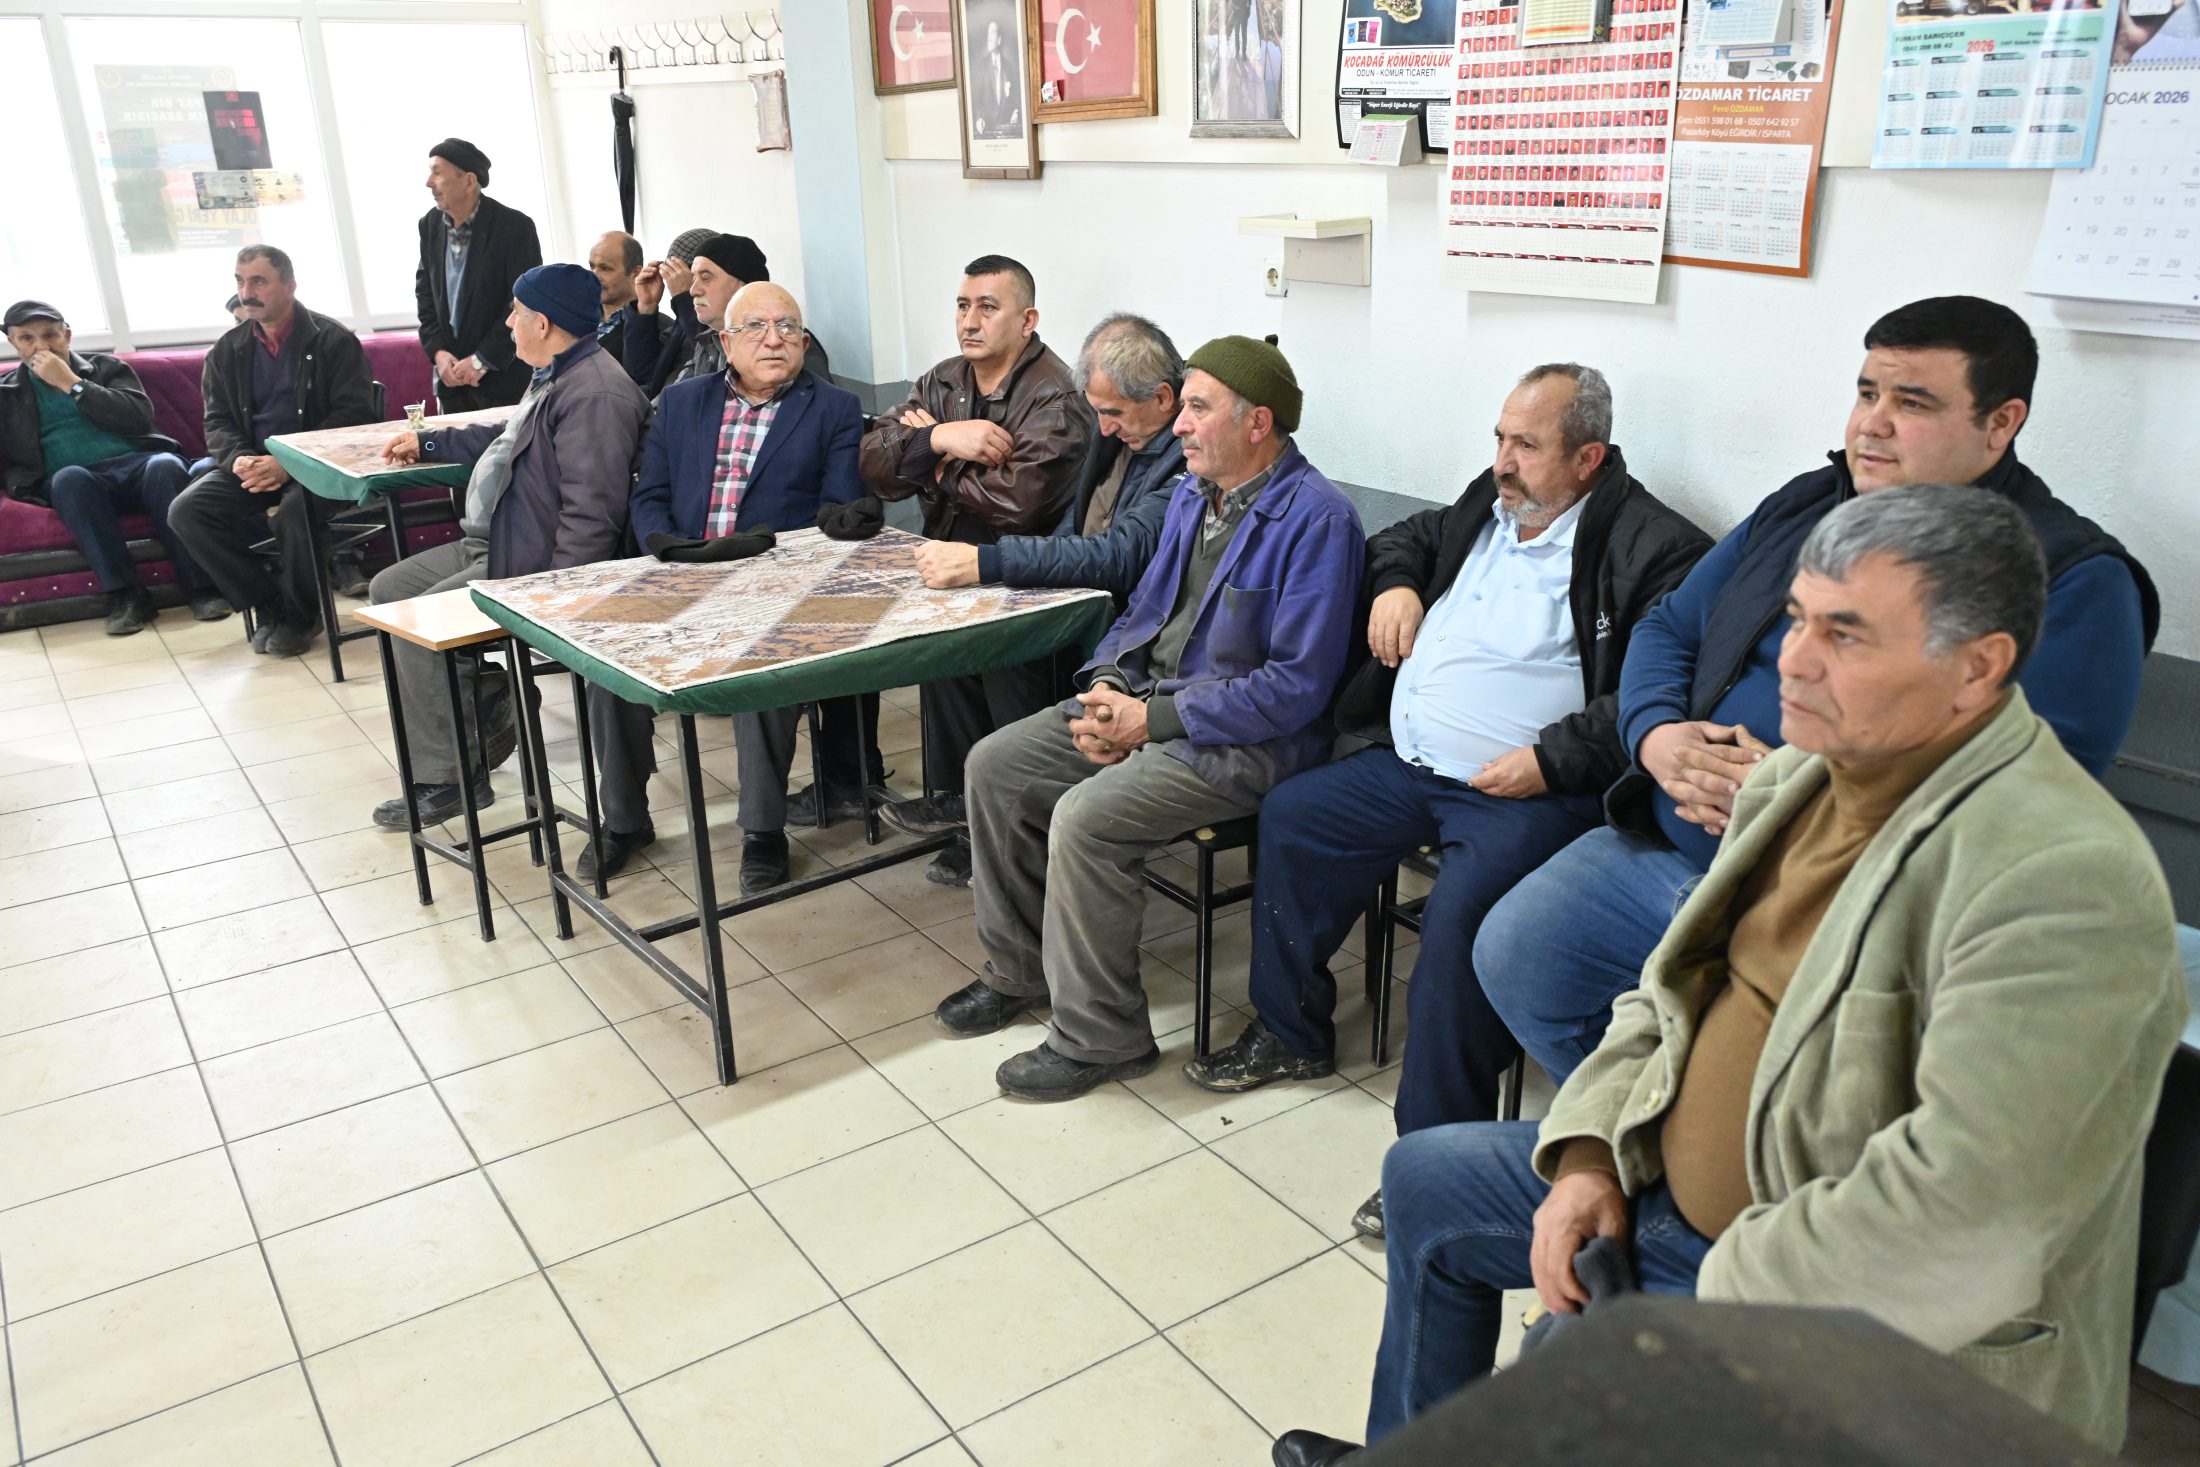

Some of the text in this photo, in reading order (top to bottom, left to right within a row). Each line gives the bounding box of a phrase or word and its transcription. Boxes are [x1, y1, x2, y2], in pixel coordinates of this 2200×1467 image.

[1967, 40, 1995, 53] 2026
[1344, 51, 1453, 68] KOCADAĞ KÖMÜRCÜLÜK
[1356, 69, 1375, 77] ODUN
[1747, 85, 1813, 101] TİCARET
[2104, 91, 2190, 105] OCAK 2026
[1730, 104, 1764, 112] ÖZDAMAR
[1694, 116, 1710, 125] 0551
[1725, 117, 1733, 125] 01
[1747, 118, 1766, 126] 0507
[1681, 128, 1710, 138] Pazarköy
[1711, 129, 1729, 138] Köyü
[1762, 129, 1792, 138] ISPARTA
[2101, 166, 2200, 176] 5 6 7 8
[2093, 195, 2196, 207] 12 13 14 15
[2086, 225, 2189, 239] 19 20 21 22
[2075, 254, 2181, 269] 26 27 28 29
